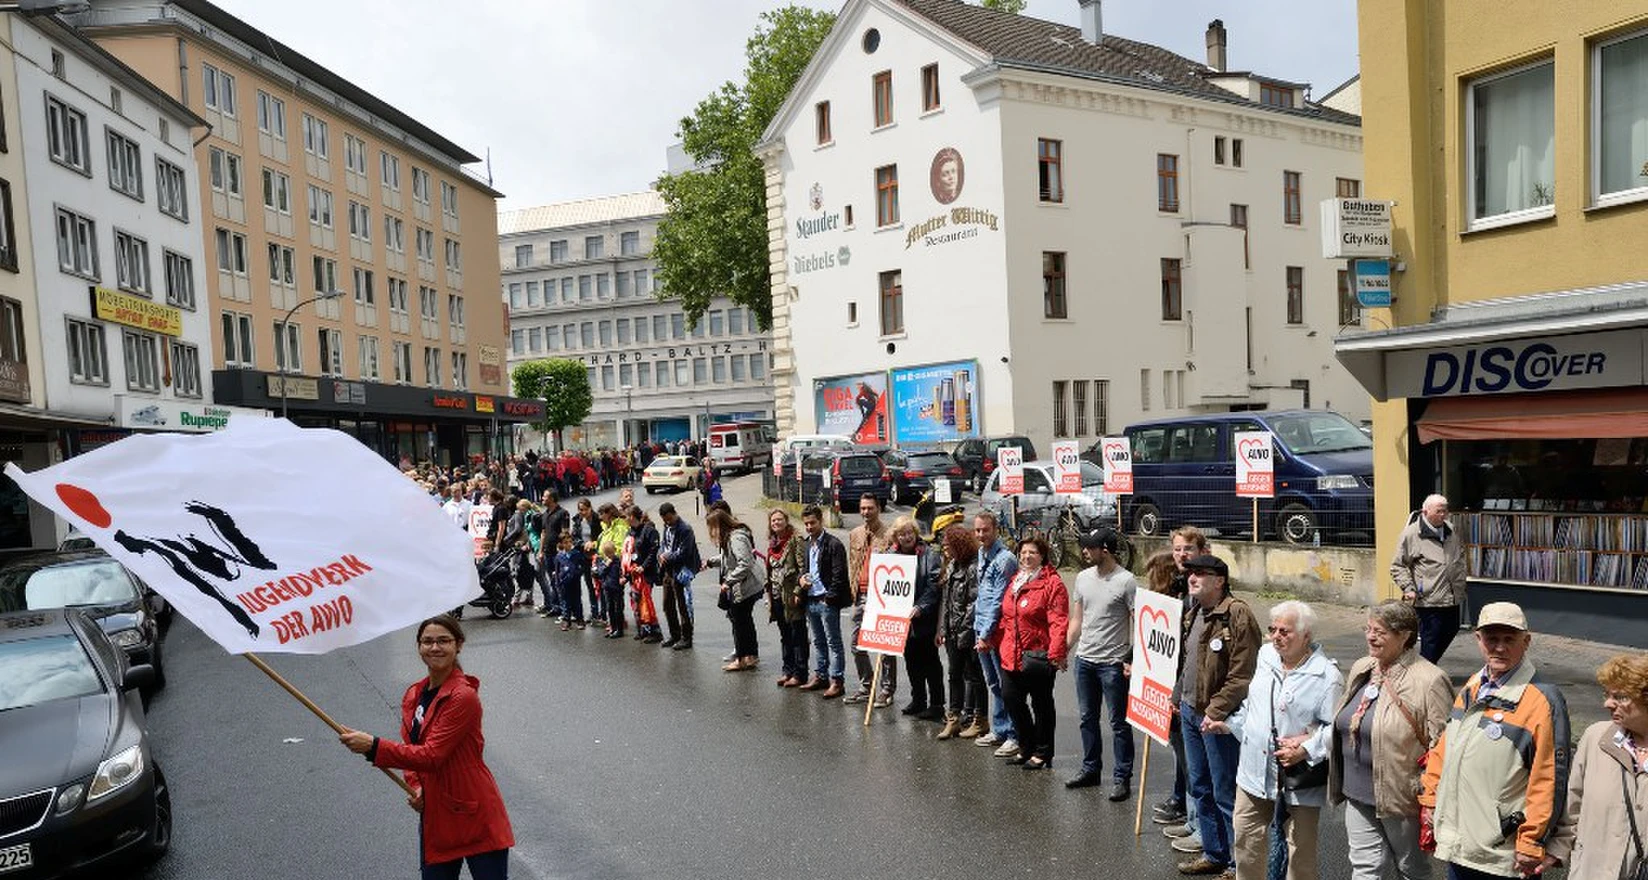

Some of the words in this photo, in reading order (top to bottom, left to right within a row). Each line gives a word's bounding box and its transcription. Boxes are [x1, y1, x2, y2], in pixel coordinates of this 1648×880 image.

[1343, 233, 1362, 247] City
[1364, 233, 1390, 246] Kiosk
[1248, 448, 1269, 460] AWO
[883, 579, 911, 598] AWO
[269, 610, 310, 645] DER
[310, 594, 353, 634] AWO
[878, 619, 906, 634] GEGEN
[1148, 629, 1176, 659] AWO
[1144, 685, 1172, 711] GEGEN
